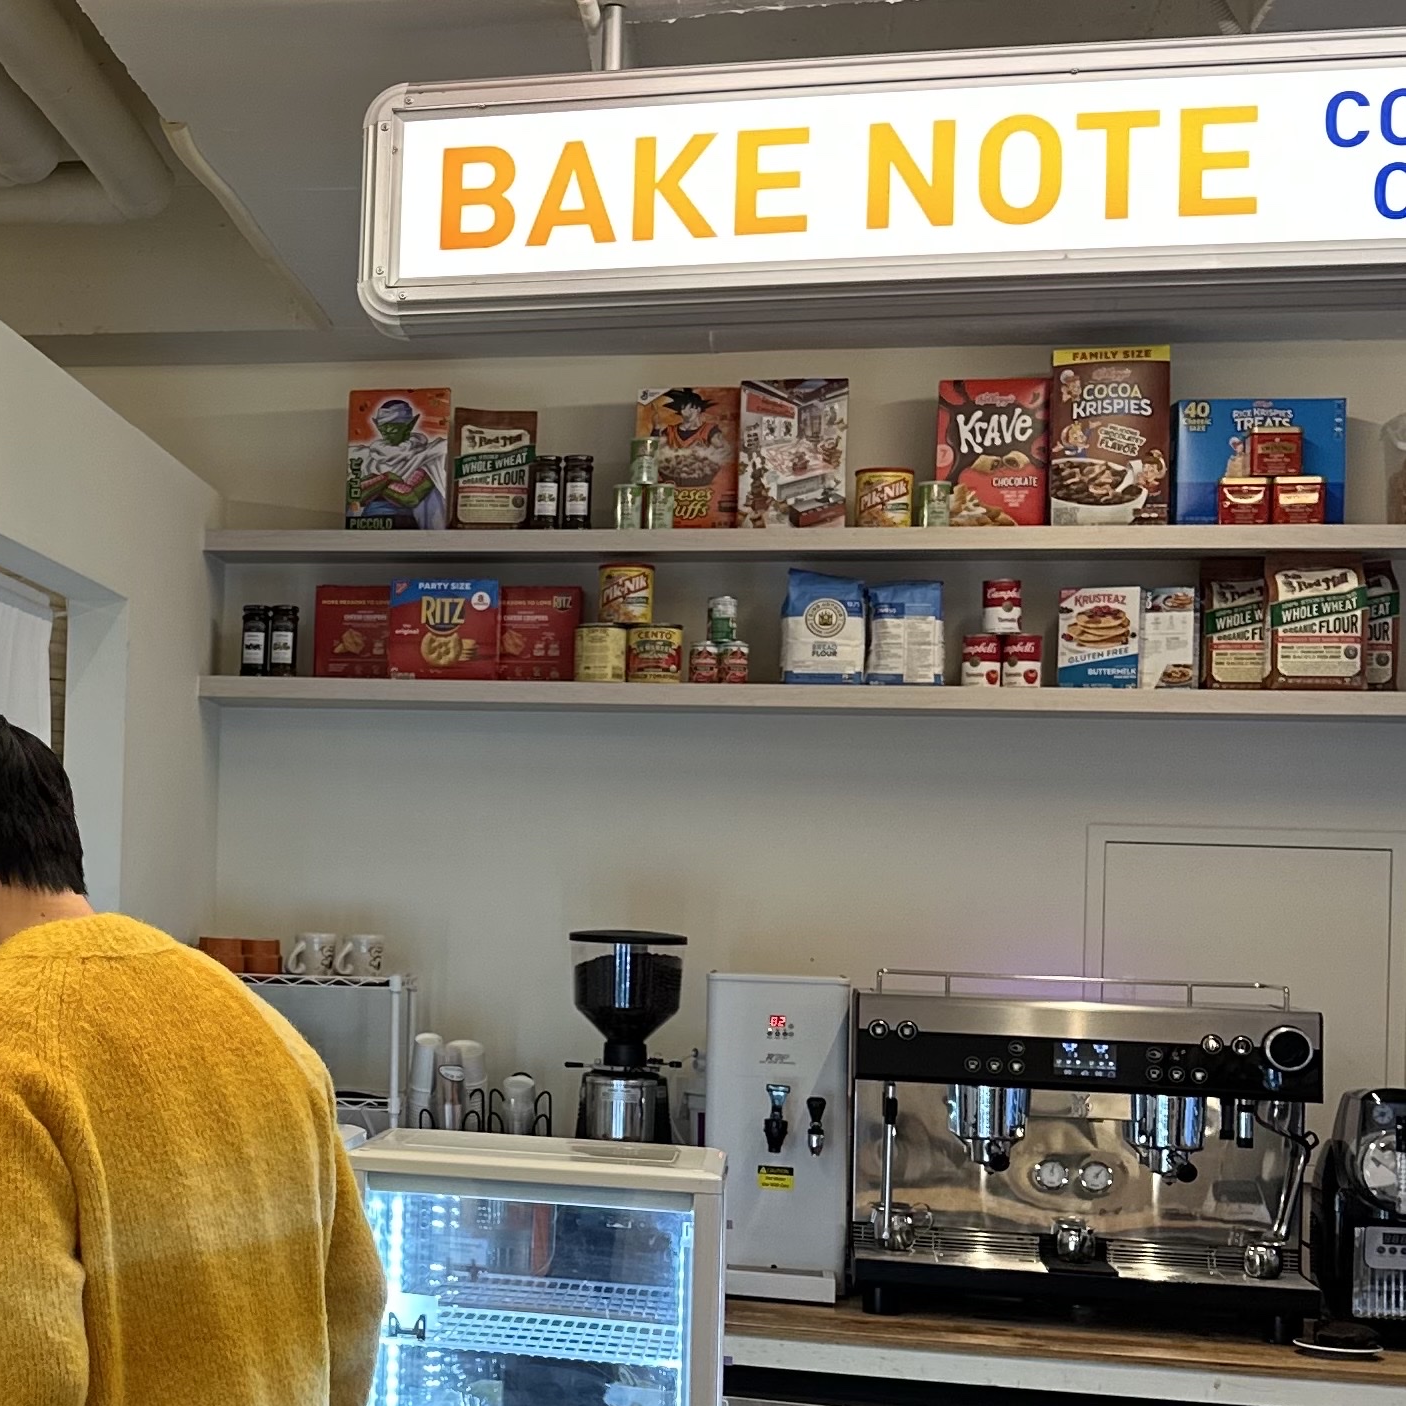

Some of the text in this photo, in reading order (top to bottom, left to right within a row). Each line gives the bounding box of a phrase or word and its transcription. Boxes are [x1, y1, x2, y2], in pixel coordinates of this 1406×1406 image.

[440, 105, 1259, 251] BAKE NOTE
[1072, 349, 1153, 361] FAMILY SIZE
[1083, 383, 1142, 401] COCOA
[1072, 399, 1153, 420] KRISPIES
[1185, 401, 1210, 418] 40
[462, 460, 493, 475] WHOLE
[495, 452, 527, 469] WHEAT
[492, 469, 525, 486] FLOUR
[992, 476, 1037, 487] CHOCOLATE
[674, 501, 708, 519] uffs
[350, 518, 392, 529] PICCOLO
[418, 582, 471, 590] PARTY SIZE
[553, 596, 572, 608] RITZ
[1074, 593, 1126, 607] KRUSTEAZ
[421, 596, 465, 625] RITZ
[1282, 597, 1358, 624] WHOLE WHEAT
[1369, 602, 1390, 618] EAT
[1216, 612, 1252, 631] WHOLE
[1283, 614, 1359, 634] ORGANIC FLOUR
[638, 631, 672, 639] CENTO
[1217, 630, 1250, 641] ORGANIC
[1068, 647, 1129, 664] GLUTEN FREE
[1087, 668, 1136, 676] BUTTERMILK
[770, 1016, 786, 1027] 82
